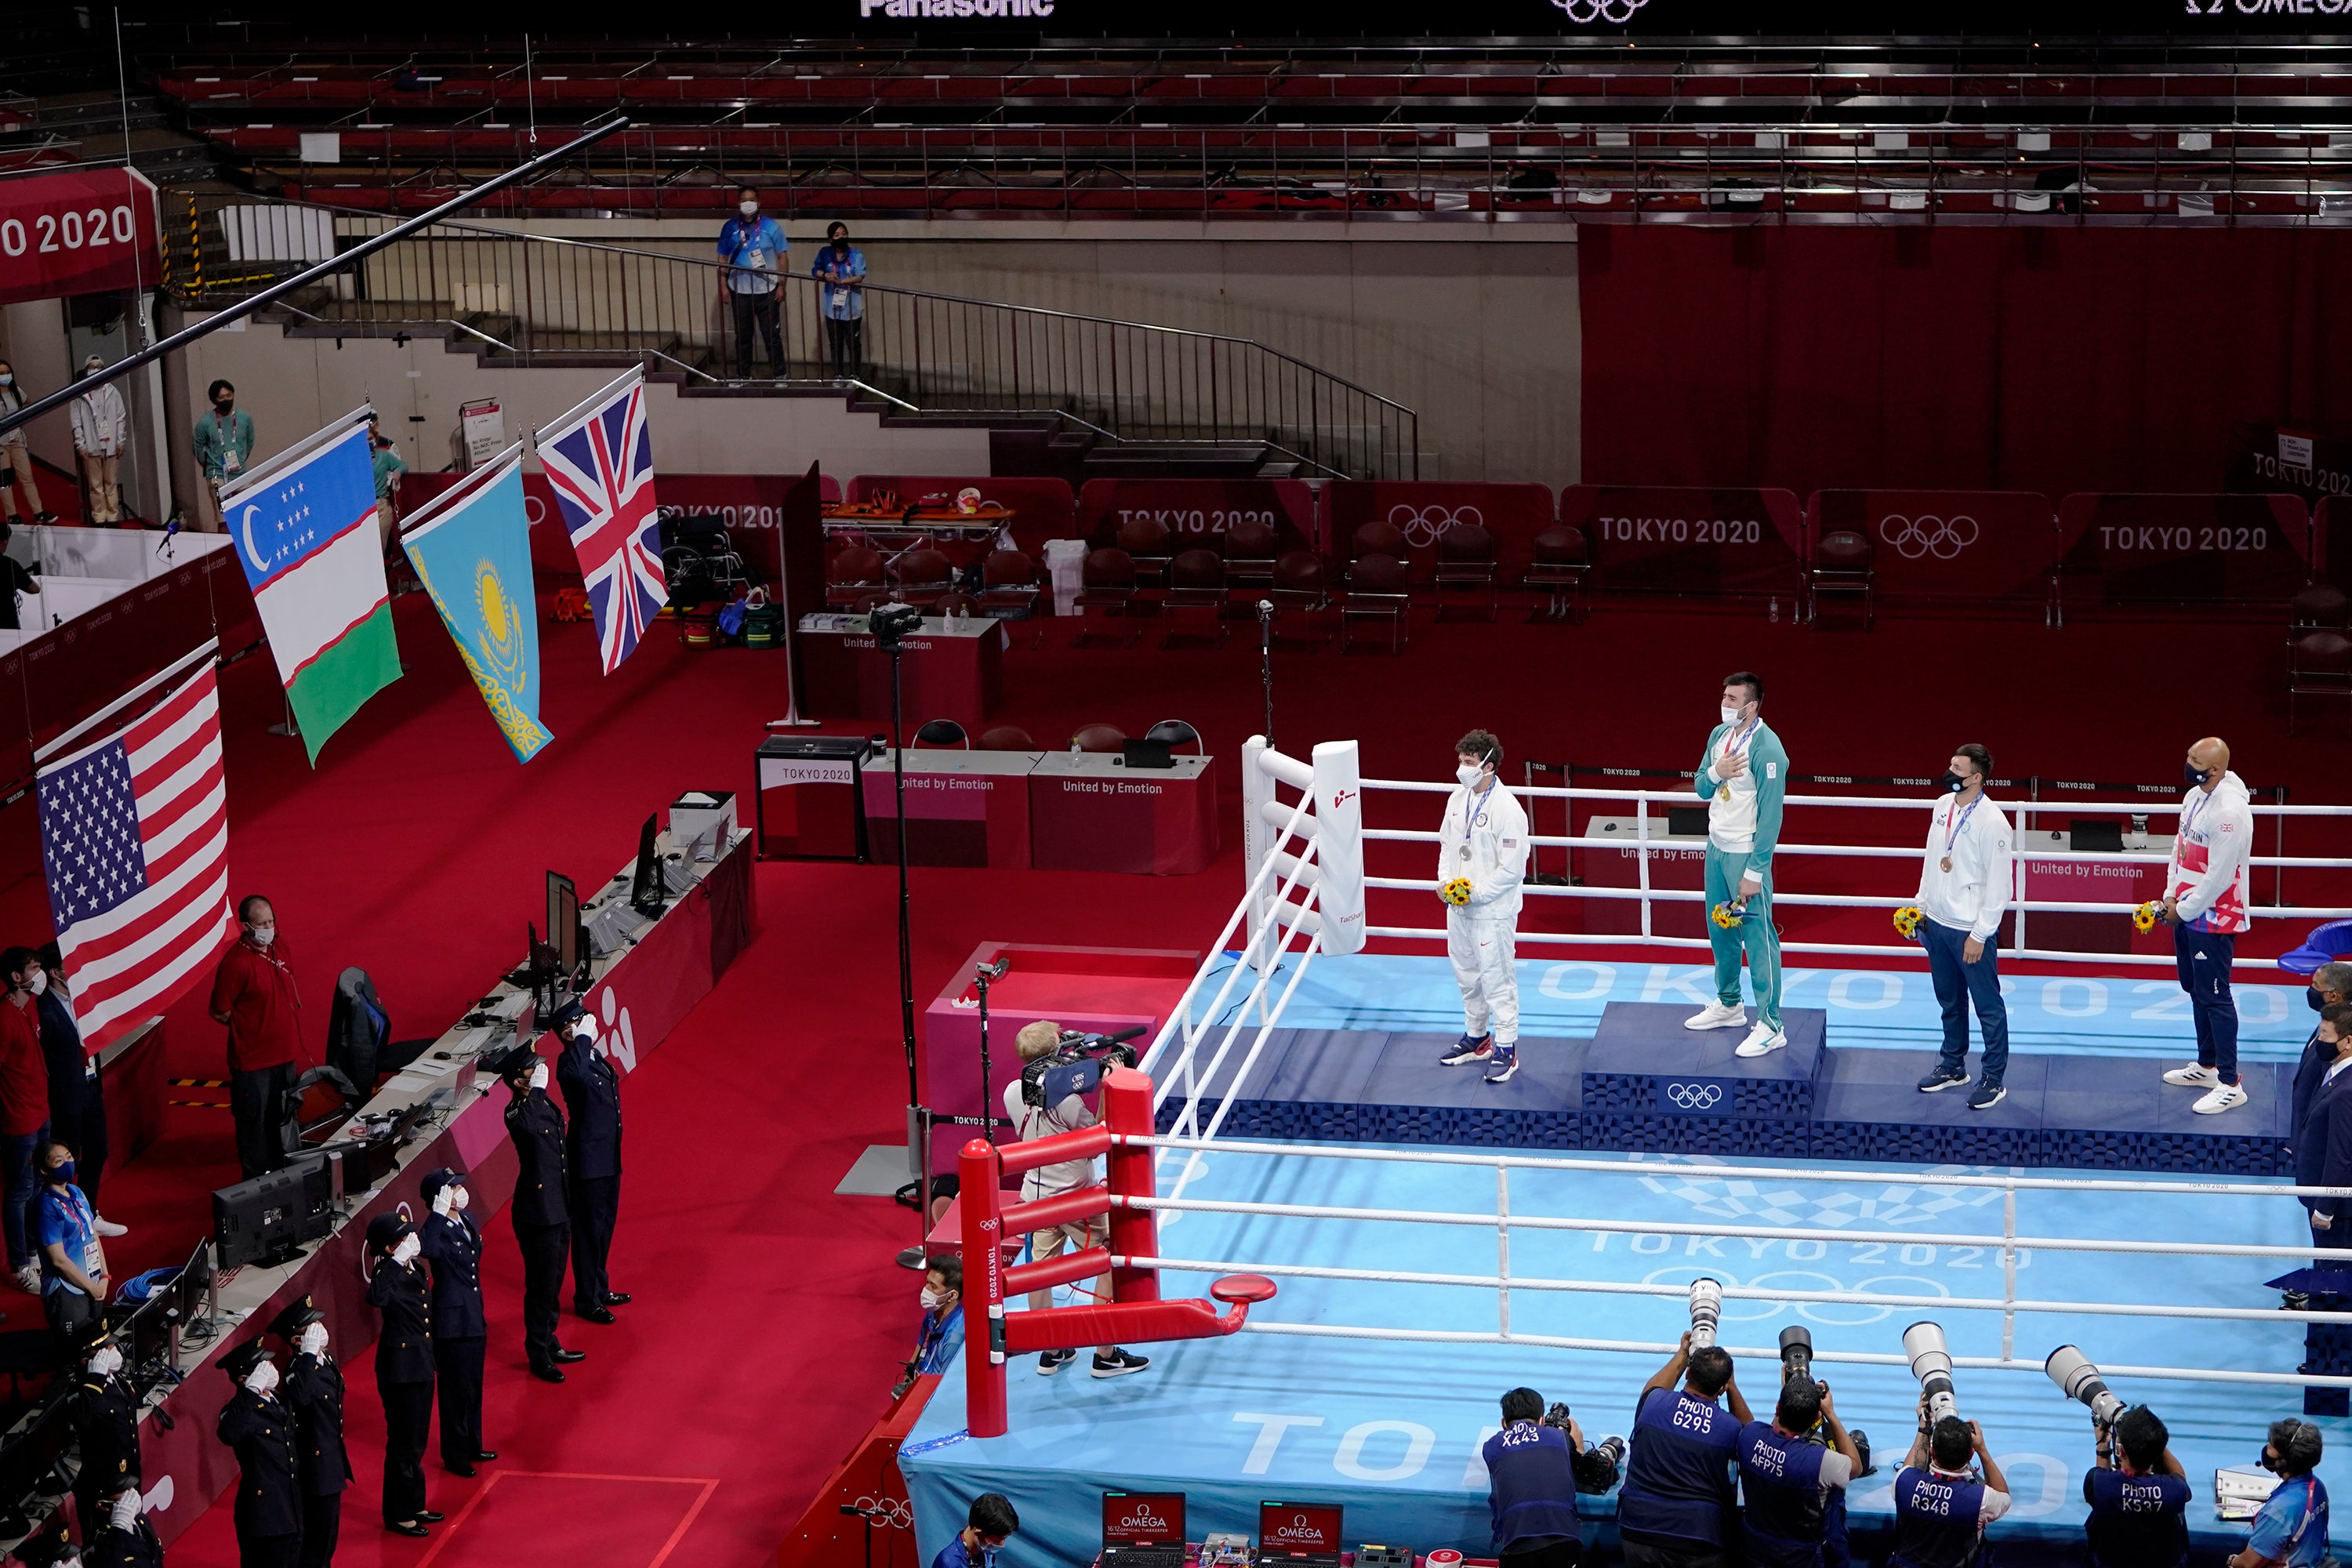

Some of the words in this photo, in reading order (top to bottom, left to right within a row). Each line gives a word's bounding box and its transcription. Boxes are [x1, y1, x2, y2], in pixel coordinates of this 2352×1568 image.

[36, 205, 134, 252] 2020
[1599, 517, 1687, 542] TOKYO
[1695, 520, 1760, 543] 2020
[2100, 527, 2191, 550] TOKYO
[2199, 528, 2267, 550] 2020
[844, 637, 876, 648] United
[900, 640, 932, 650] motion
[782, 768, 820, 779] TOKYO
[822, 768, 851, 780] 2020
[902, 778, 931, 789] nited
[934, 778, 946, 791] by
[949, 778, 994, 790] Emotion
[1063, 781, 1098, 793] United
[1102, 782, 1115, 795] by
[1117, 782, 1163, 794] Emotion
[1621, 848, 1659, 858] Uned
[1664, 848, 1676, 861] by
[2032, 862, 2072, 875] United
[2076, 864, 2090, 877] by
[2093, 865, 2143, 878] Emotion
[954, 1116, 978, 1125] TOKYO
[980, 1117, 999, 1127] 220
[1585, 1230, 1828, 1261] TOKYO
[1849, 1240, 2032, 1270] 2020
[988, 1246, 996, 1276] TOKYO
[989, 1276, 998, 1298] 2020
[1678, 1397, 1713, 1418] PHOTO
[1673, 1410, 1711, 1434] G295
[1502, 1432, 1540, 1447] X443
[1754, 1439, 1786, 1464] PHOTO
[1751, 1453, 1783, 1477] AFP75
[1915, 1479, 1953, 1500] PHOTO
[2122, 1483, 2161, 1499] PHOTO
[1911, 1494, 1950, 1515] R348
[2123, 1497, 2163, 1512] K537
[1121, 1516, 1167, 1527] OMEGA
[1278, 1526, 1323, 1539] OMEGA
